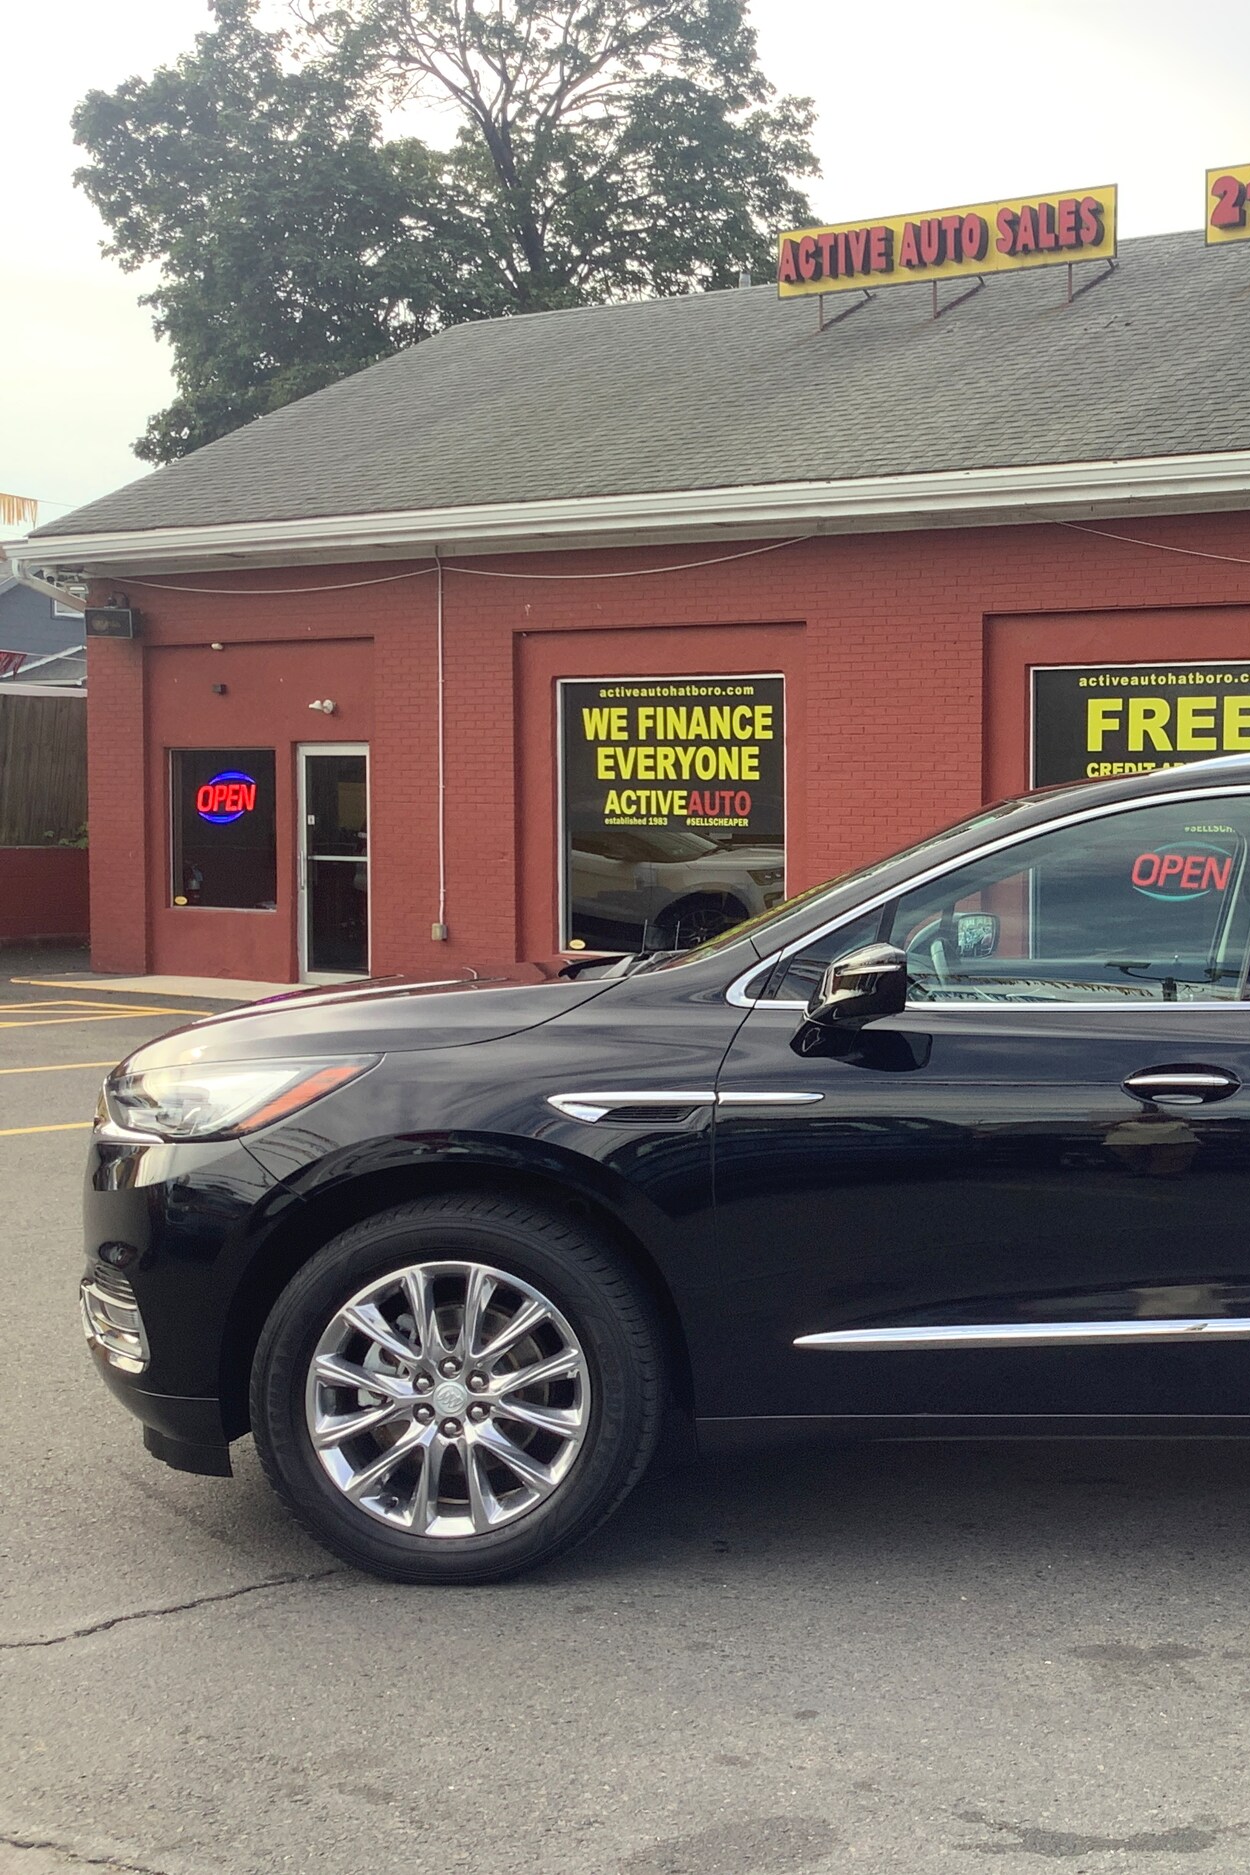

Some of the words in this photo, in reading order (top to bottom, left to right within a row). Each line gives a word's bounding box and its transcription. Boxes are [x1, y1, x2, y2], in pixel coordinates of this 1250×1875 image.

[778, 226, 892, 282] ACTIVE
[900, 213, 987, 267] AUTO
[996, 196, 1103, 254] SALES
[599, 685, 754, 698] activeautohatboro.com
[582, 707, 628, 740] WE
[638, 705, 773, 740] FINANCE
[597, 746, 760, 780] EVERYONE
[197, 784, 256, 812] OPEN
[604, 816, 647, 825] established
[648, 817, 668, 826] 1983
[686, 817, 749, 827] #SELLSCHEAPER
[1131, 853, 1232, 890] OPEN
